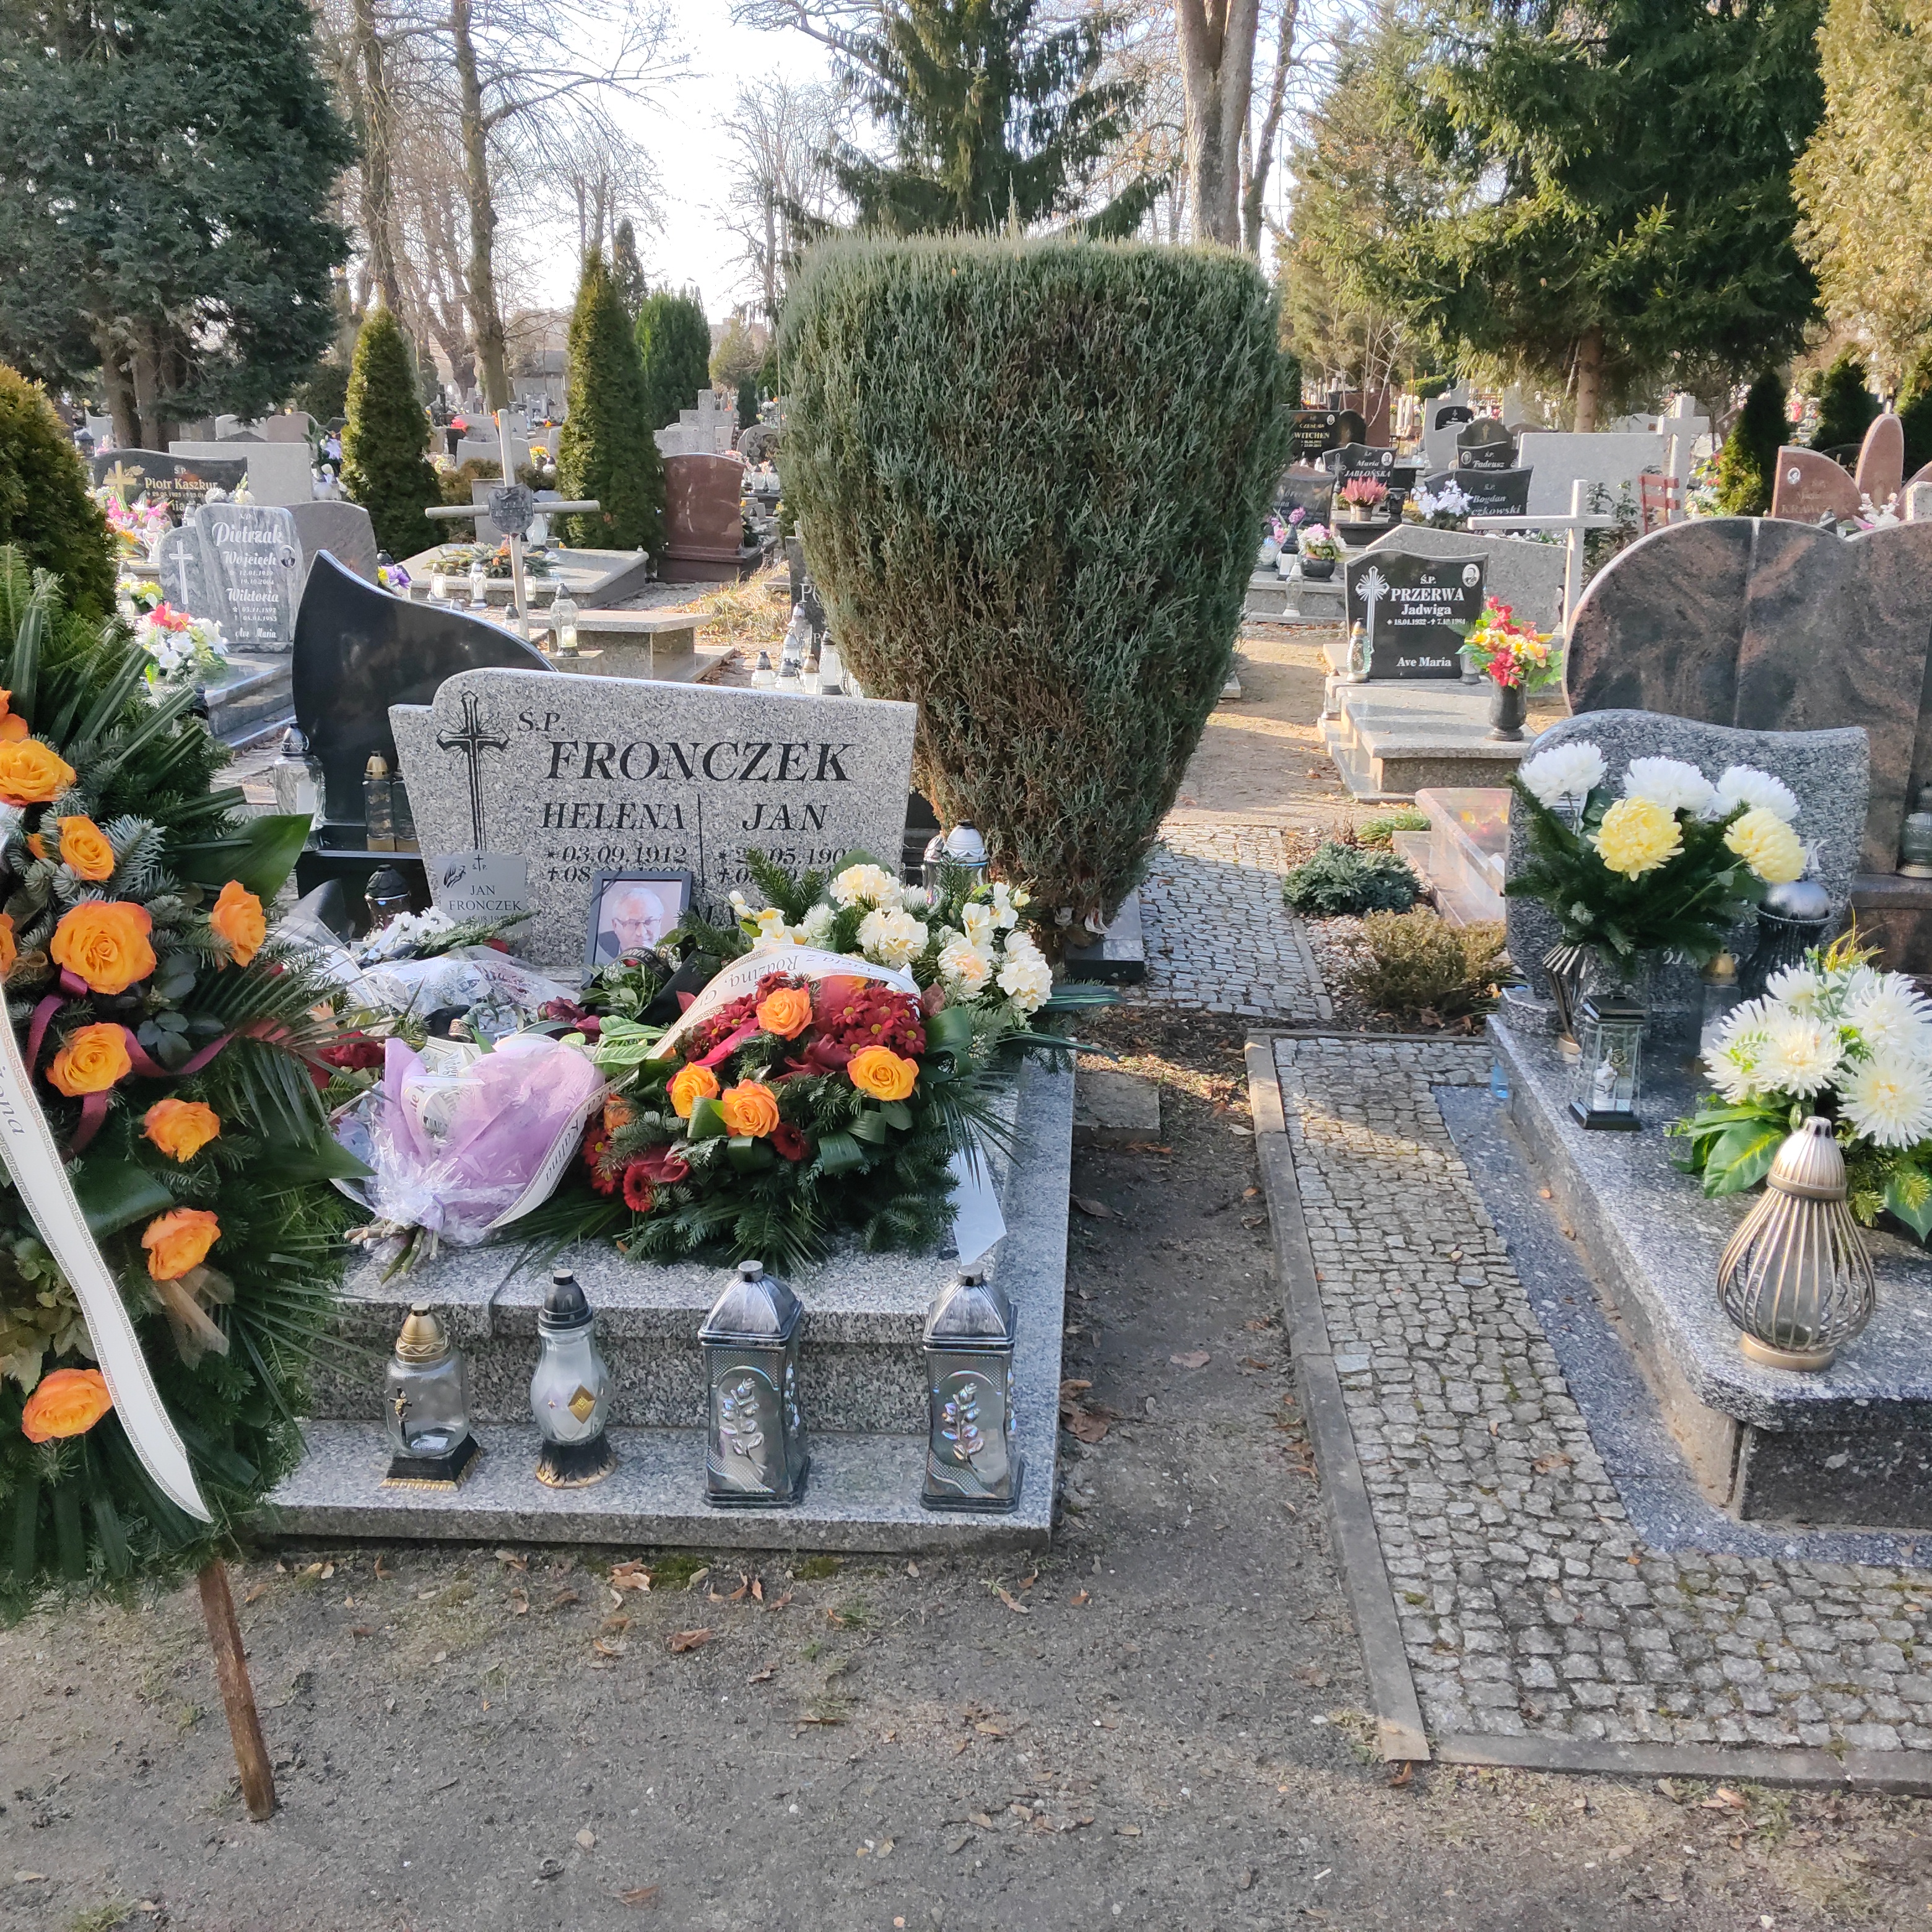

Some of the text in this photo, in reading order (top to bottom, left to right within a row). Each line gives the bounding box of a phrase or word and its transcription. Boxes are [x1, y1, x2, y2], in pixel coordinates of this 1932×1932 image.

[1473, 459, 1505, 468] Tadeusz
[144, 477, 219, 490] Piotr Kaszkur
[1473, 495, 1506, 504] Bogdan
[1471, 505, 1521, 516] czkowski
[212, 522, 283, 546] Pietrzak
[223, 551, 277, 567] Wojciech
[1420, 574, 1437, 584] Ś.P.
[225, 588, 279, 603] Wiktoria
[1390, 588, 1464, 602] PRZERWA
[1401, 604, 1452, 617] Jadwiga
[255, 627, 277, 638] Maria
[1396, 656, 1452, 667] Ave Maria
[544, 741, 853, 782] FRONCZEK
[539, 803, 687, 830] HELENA
[743, 804, 829, 832] JAN
[470, 885, 495, 895] JAN
[449, 900, 523, 911] FRONCZEK
[806, 954, 816, 962] z
